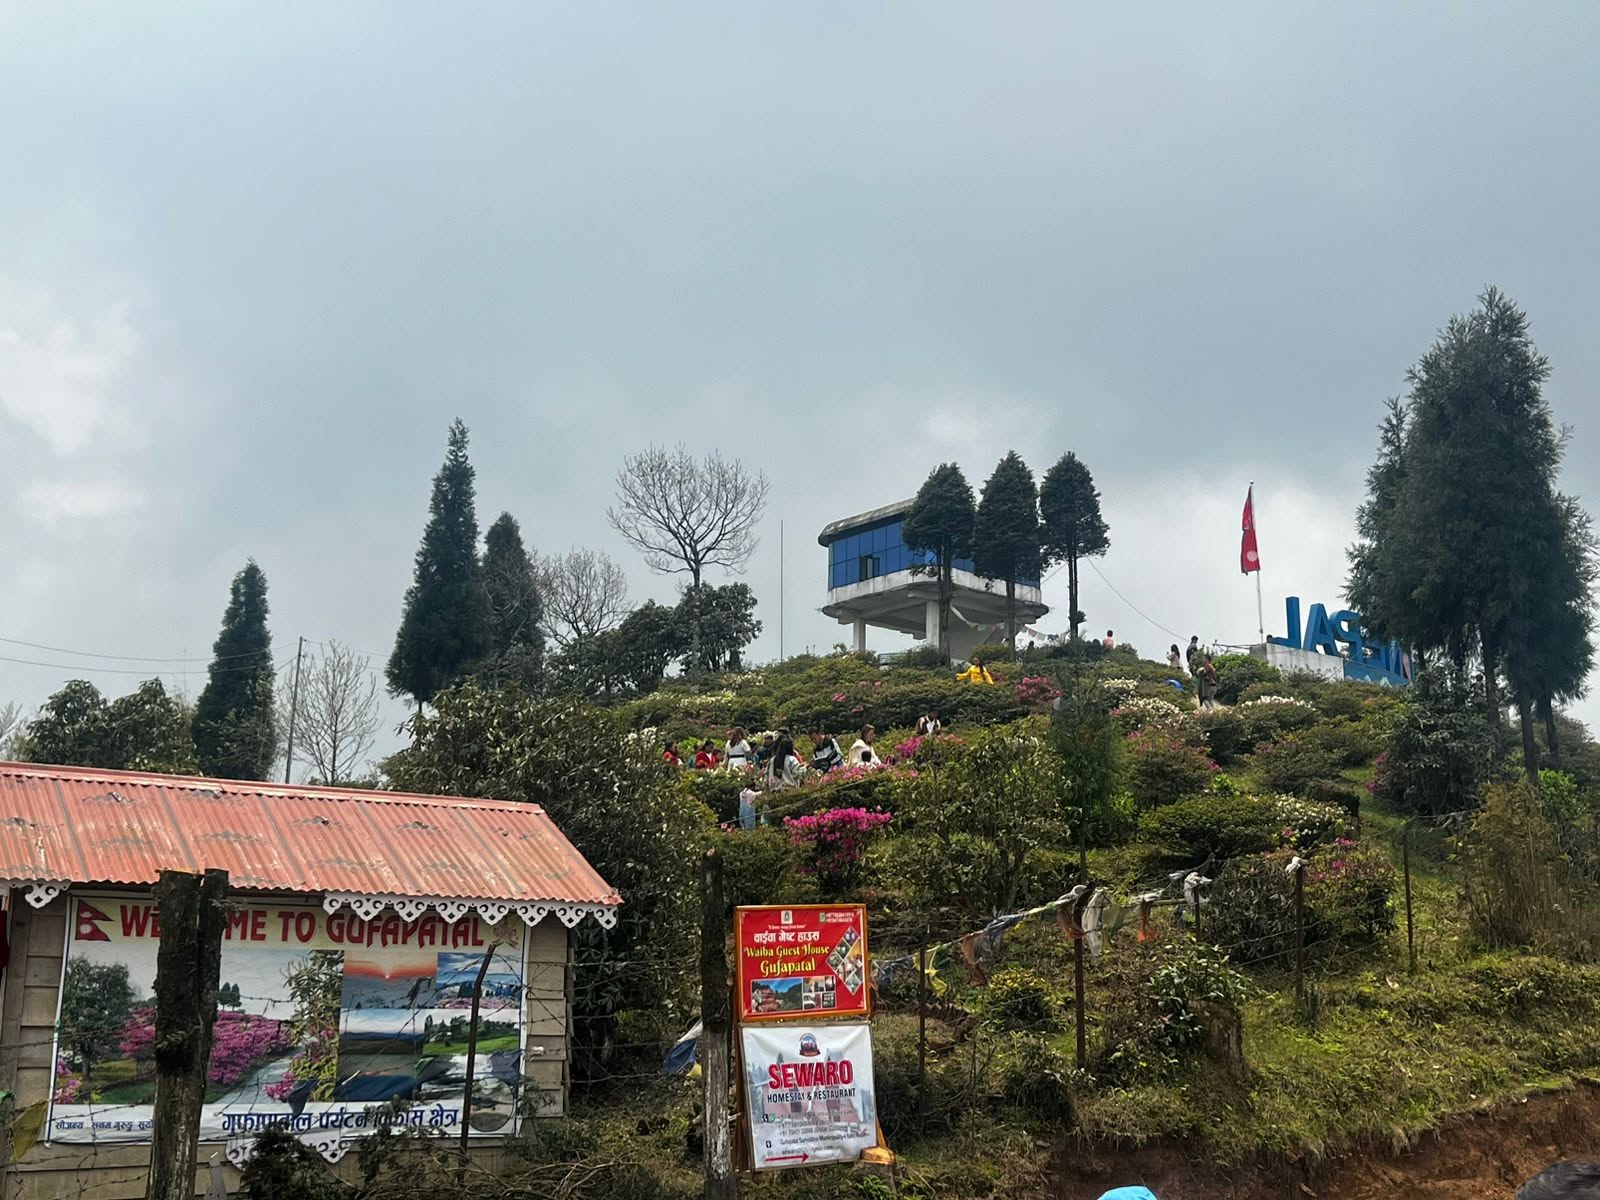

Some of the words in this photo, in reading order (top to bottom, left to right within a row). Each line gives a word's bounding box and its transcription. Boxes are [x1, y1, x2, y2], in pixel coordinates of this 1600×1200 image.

[120, 904, 267, 941] WEME
[277, 910, 316, 943] TO
[326, 912, 485, 950] GUFAPATAL
[744, 945, 774, 958] Waiba
[776, 945, 801, 960] Guest
[801, 943, 830, 957] House
[760, 957, 816, 978] Gufapatal
[768, 1059, 854, 1090] SEWARO
[767, 1091, 805, 1104] HOMESTAY
[806, 1090, 813, 1101] &
[813, 1087, 856, 1101] RESTAURANT
[429, 1103, 460, 1128] क्षेत्र
